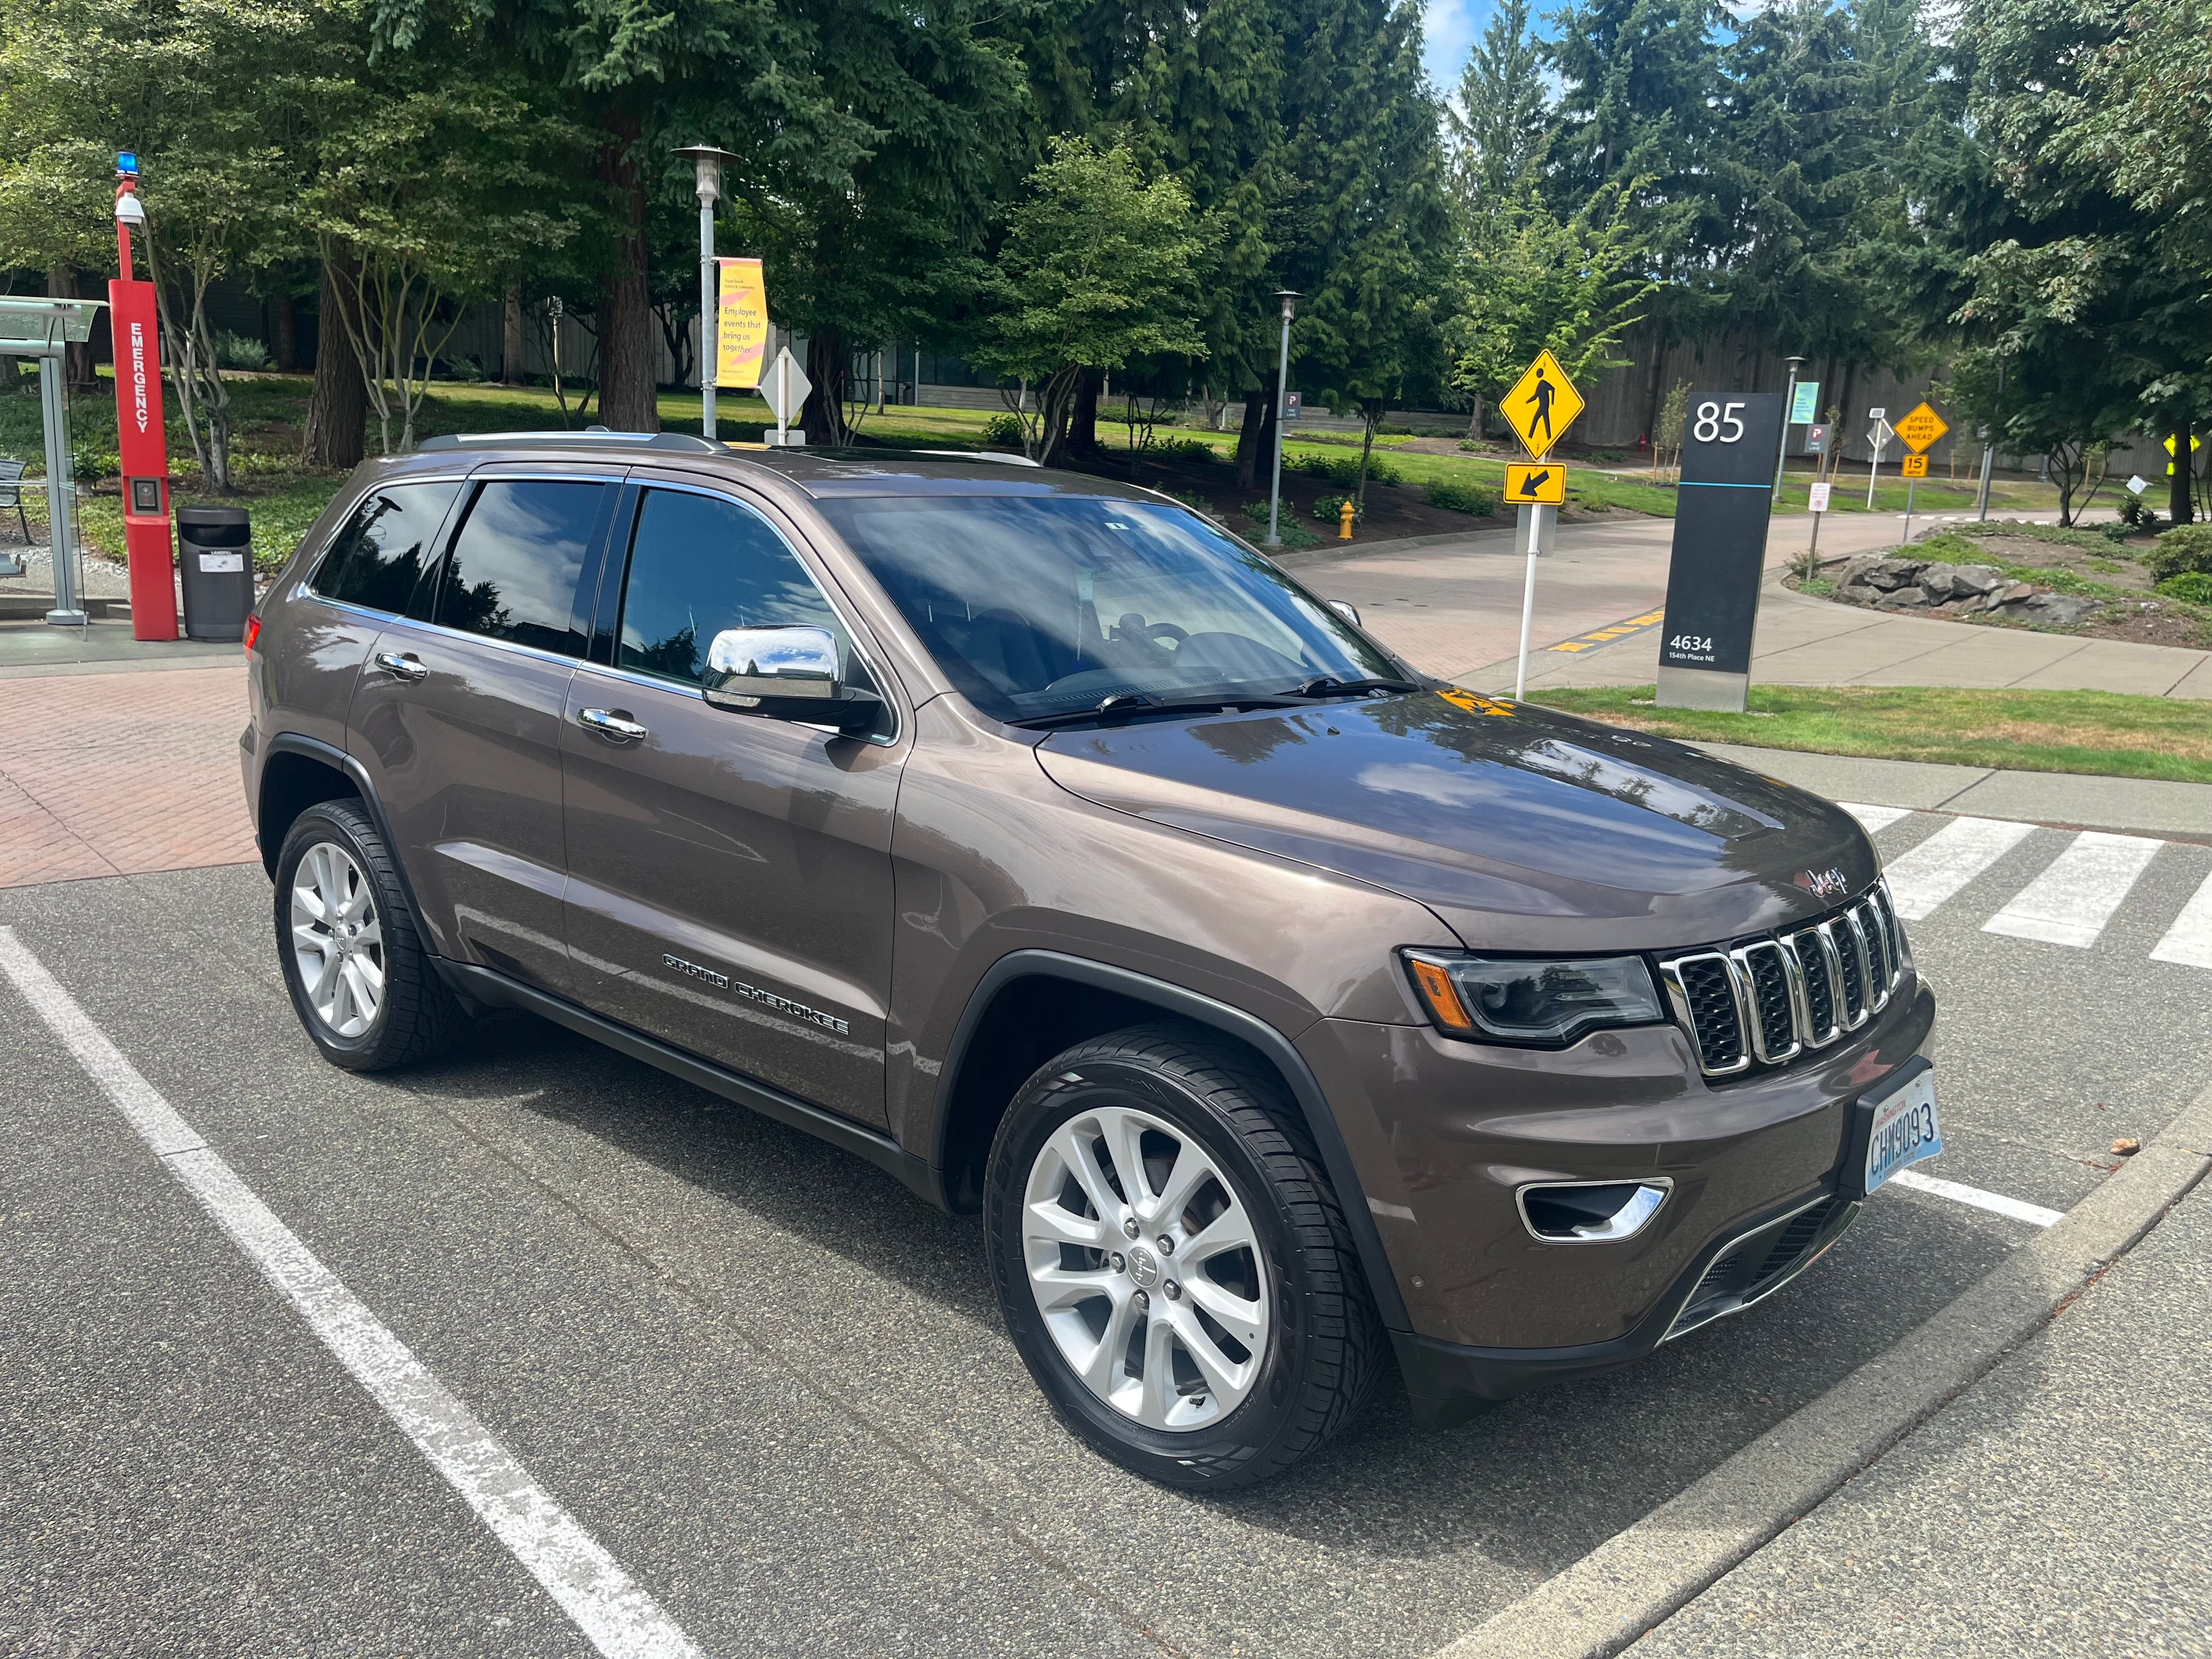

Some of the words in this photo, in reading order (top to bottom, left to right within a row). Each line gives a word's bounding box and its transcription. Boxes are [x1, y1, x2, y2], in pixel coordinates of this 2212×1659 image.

[725, 307, 757, 318] Employee
[748, 320, 761, 329] that
[723, 343, 752, 354] together.
[724, 331, 741, 342] bring
[131, 323, 148, 433] EMERGENCY
[1693, 402, 1745, 443] 85
[1909, 458, 1923, 469] 15
[1670, 635, 1712, 652] 4634
[1804, 867, 1848, 898] Jeep
[662, 953, 729, 989] GRAND
[734, 981, 849, 1035] CHEROKEE
[1875, 1099, 1907, 1130] WASHINGTON
[1871, 1102, 1934, 1176] CHM9093
